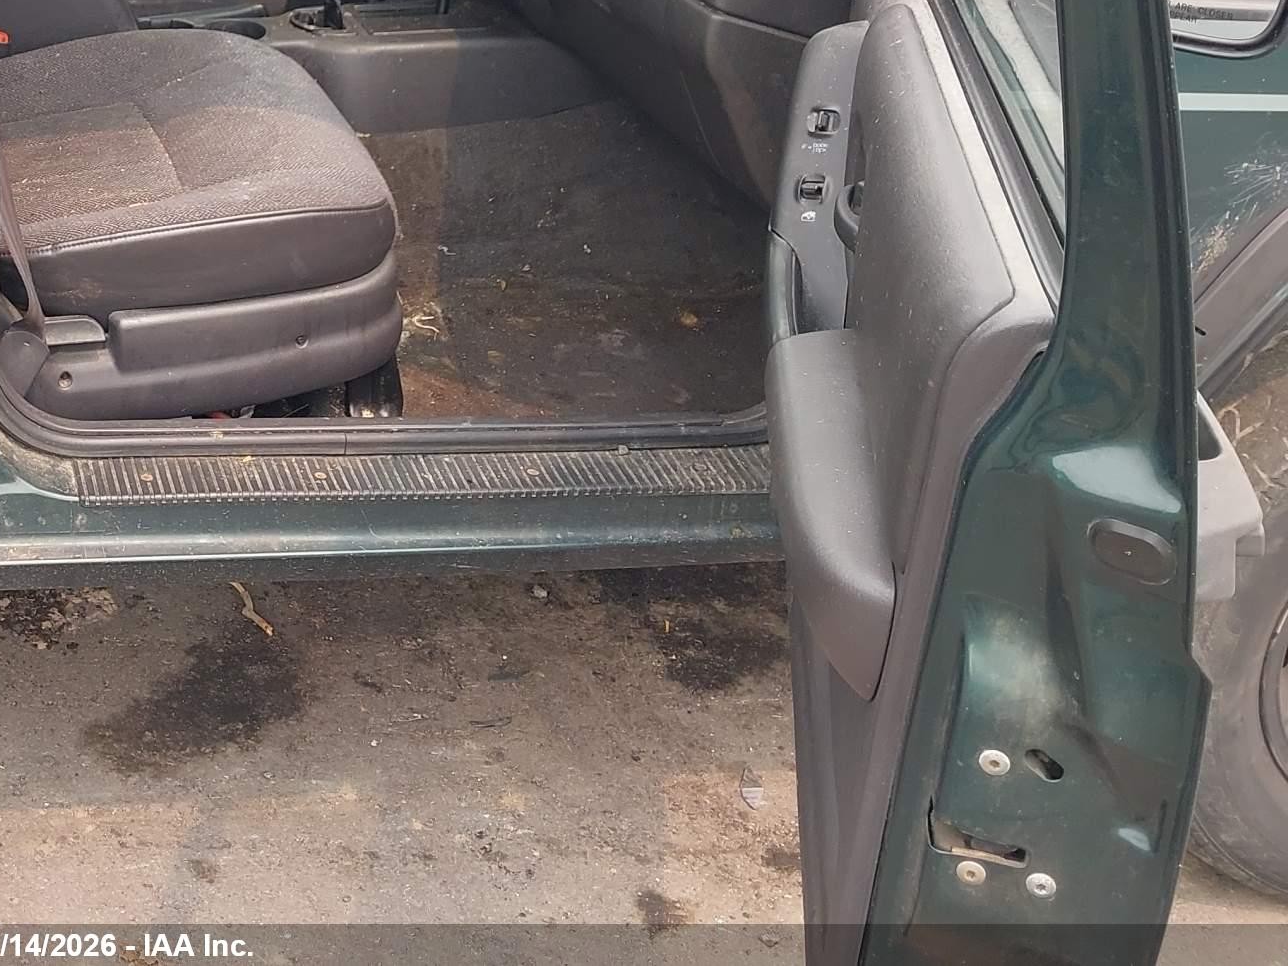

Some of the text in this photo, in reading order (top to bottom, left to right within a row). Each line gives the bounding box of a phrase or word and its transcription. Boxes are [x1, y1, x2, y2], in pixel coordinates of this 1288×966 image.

[1169, 10, 1198, 25] PPEAR
[1175, 2, 1193, 13] ARE
[1198, 6, 1233, 20] CLOSER
